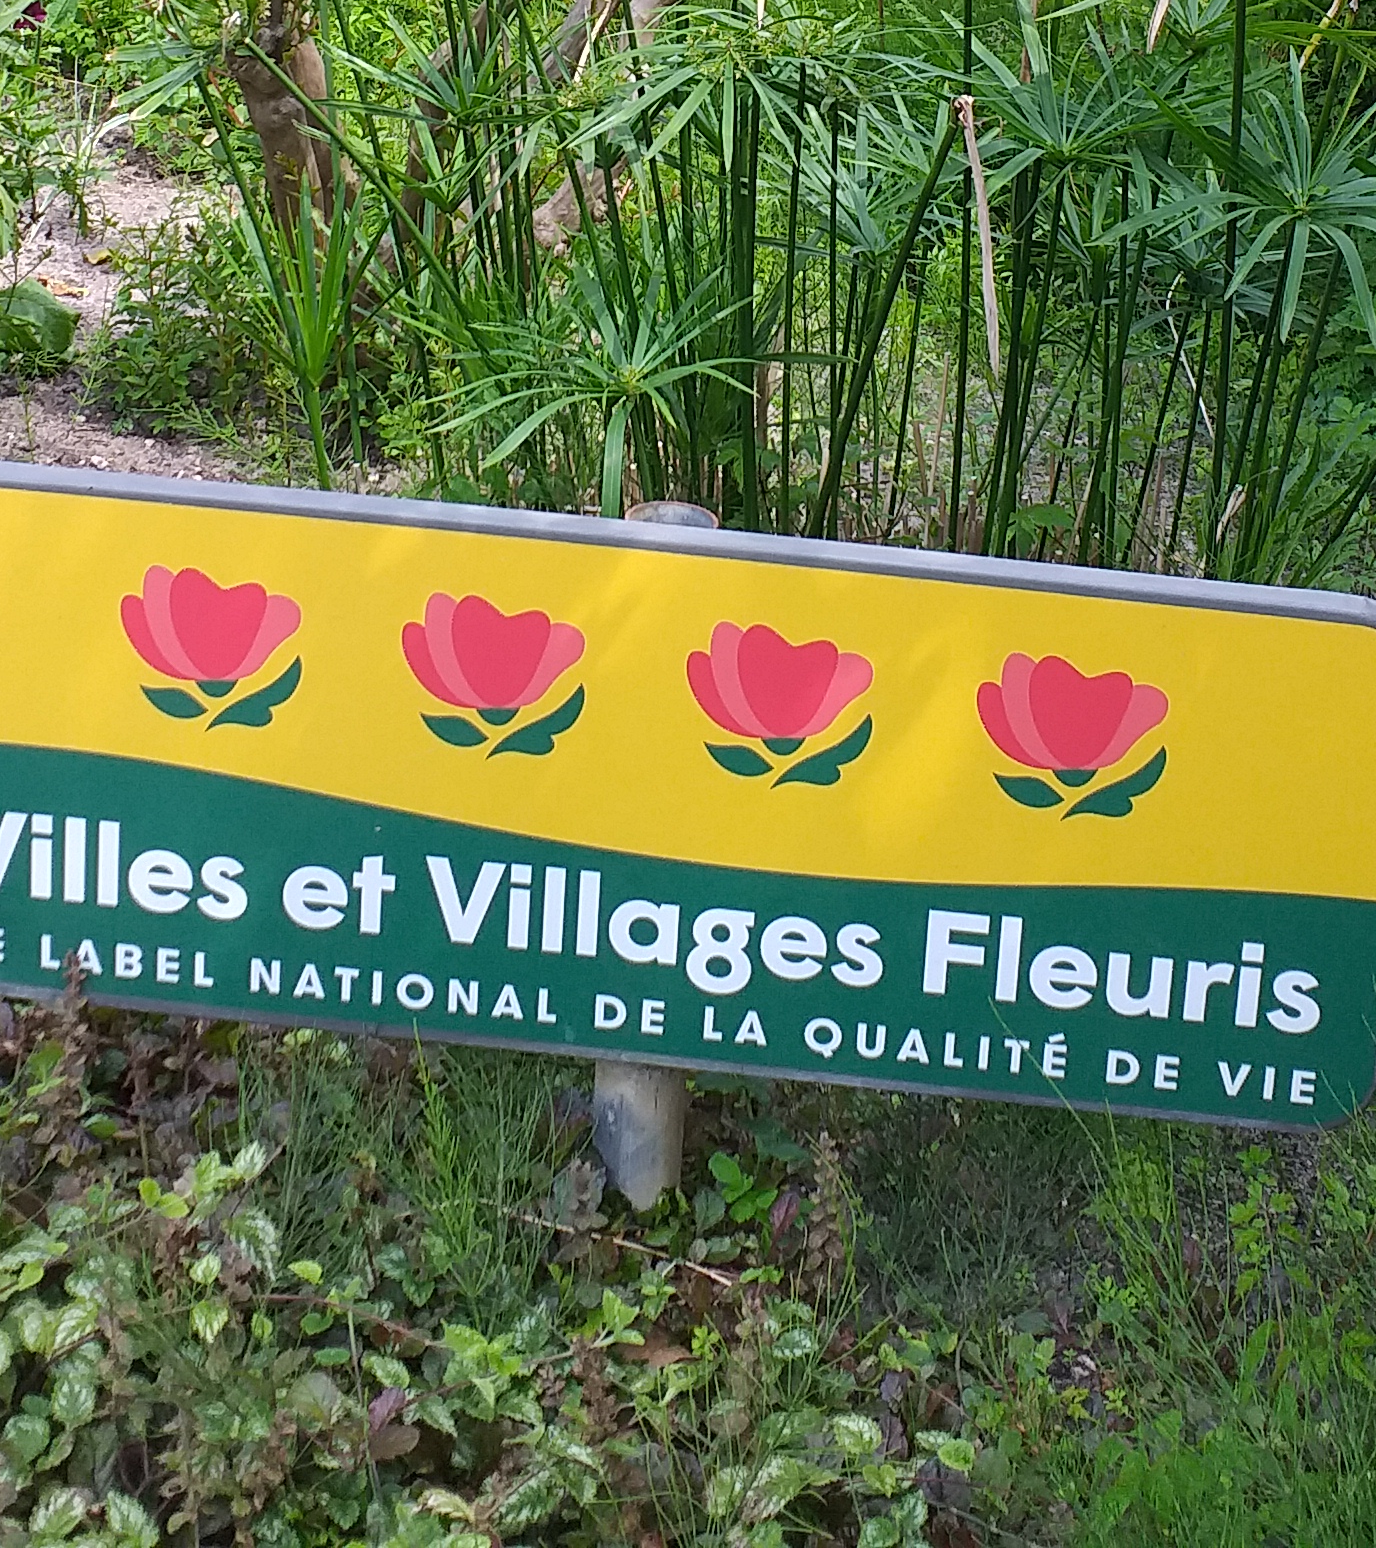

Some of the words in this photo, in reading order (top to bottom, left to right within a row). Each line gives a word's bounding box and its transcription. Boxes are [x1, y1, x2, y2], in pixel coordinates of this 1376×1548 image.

[39, 933, 214, 988] LABEL
[249, 957, 557, 1024] NATIONAL
[593, 994, 666, 1036] DE
[702, 1005, 768, 1047] LA
[803, 1017, 1068, 1079] QUALITÉ
[1105, 1049, 1180, 1091] DE
[1217, 1061, 1317, 1106] VIE
[282, 855, 397, 936] et
[425, 855, 884, 995] Villages
[922, 908, 1321, 1034] Fleuris
